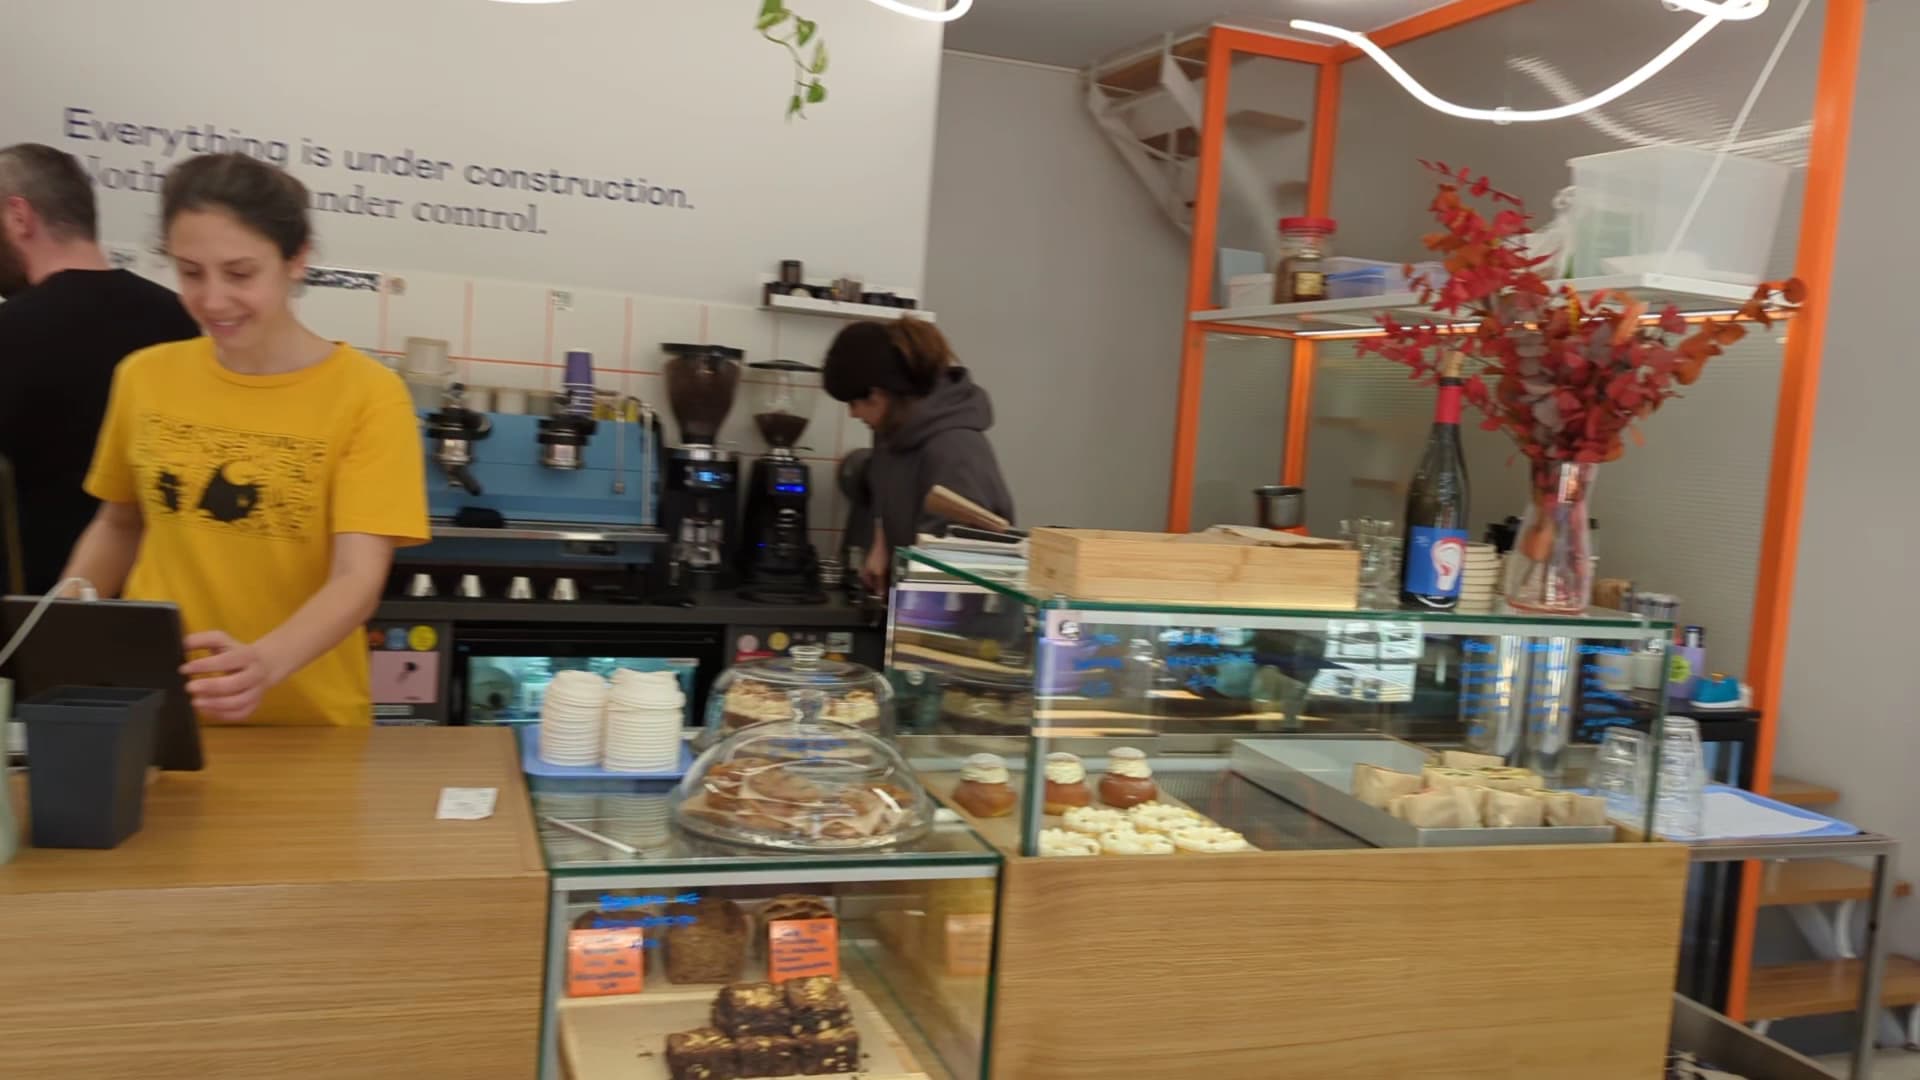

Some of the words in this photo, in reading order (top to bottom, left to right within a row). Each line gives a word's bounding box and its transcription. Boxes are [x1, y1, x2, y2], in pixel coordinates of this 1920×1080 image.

[63, 106, 290, 167] Everything
[301, 137, 332, 168] is
[343, 148, 454, 181] under
[463, 160, 696, 210] construction.
[308, 184, 403, 219] nder
[411, 198, 548, 235] control.
